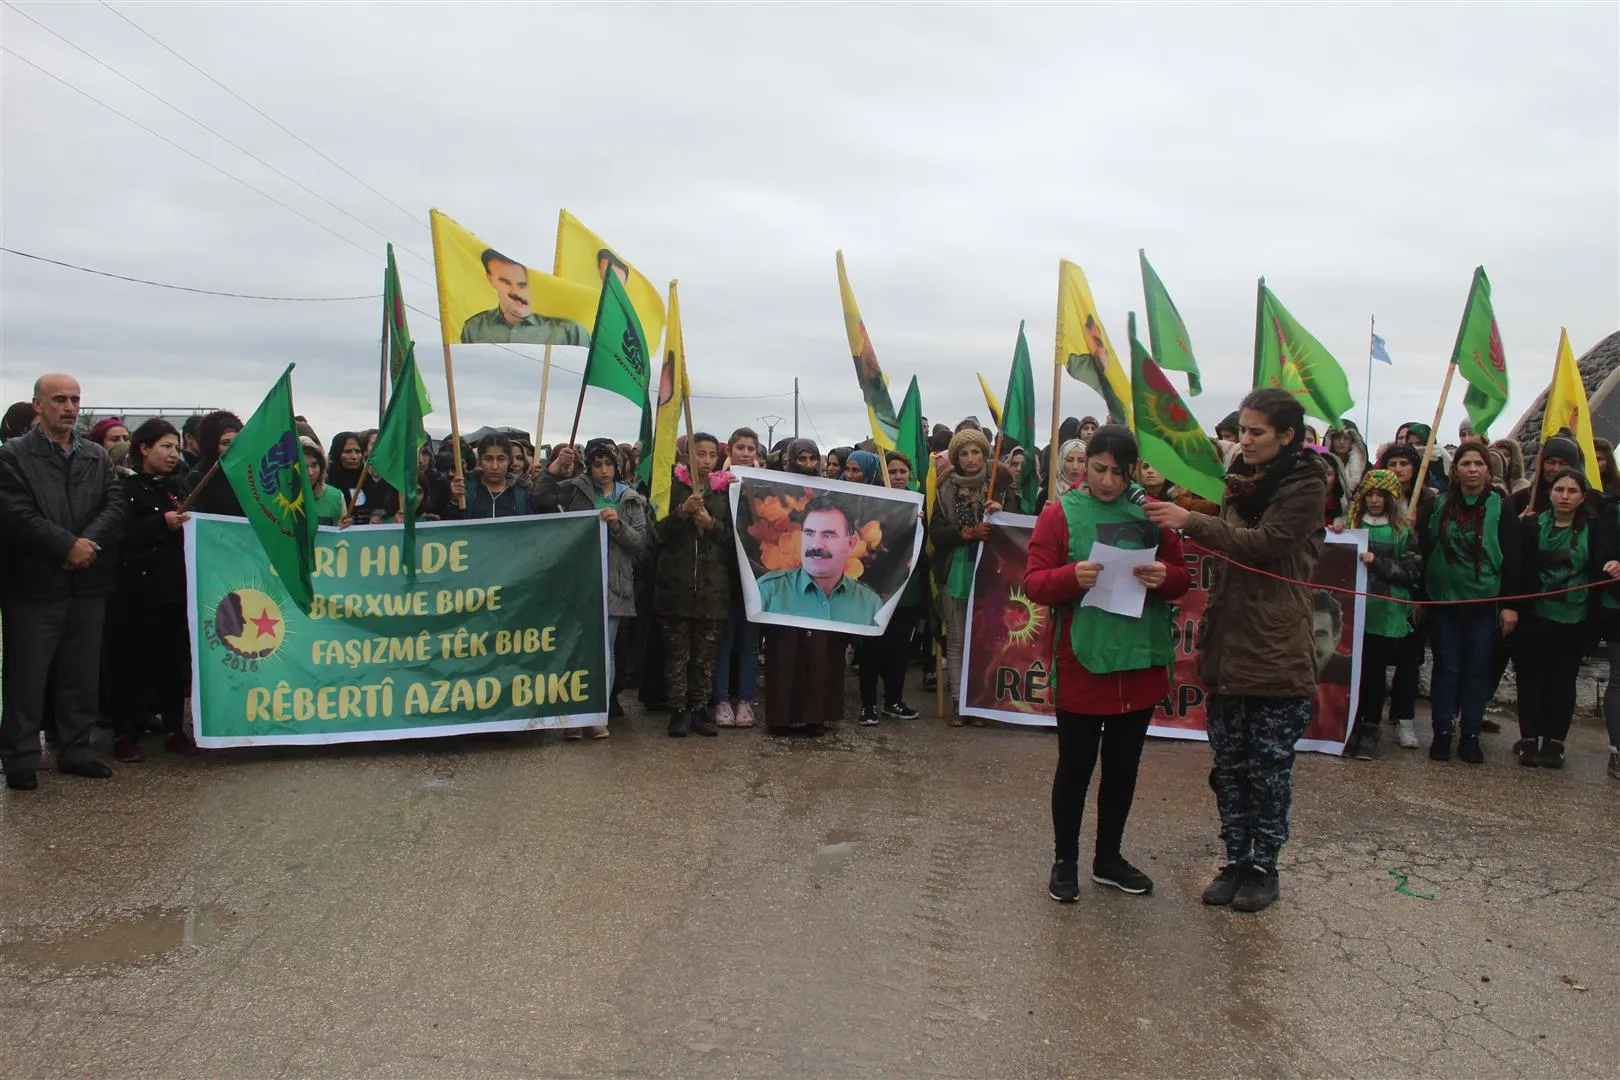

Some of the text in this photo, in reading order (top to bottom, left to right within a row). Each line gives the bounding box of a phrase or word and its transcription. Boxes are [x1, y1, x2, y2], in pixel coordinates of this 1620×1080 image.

[360, 540, 470, 578] HIDE
[309, 585, 502, 620] BERXWE BIDE
[312, 626, 556, 668] FAŞIZMÊ TÊK BIBE
[246, 670, 590, 722] RÊBERTÎ AZAD BIKE
[995, 658, 1055, 706] RÊ
